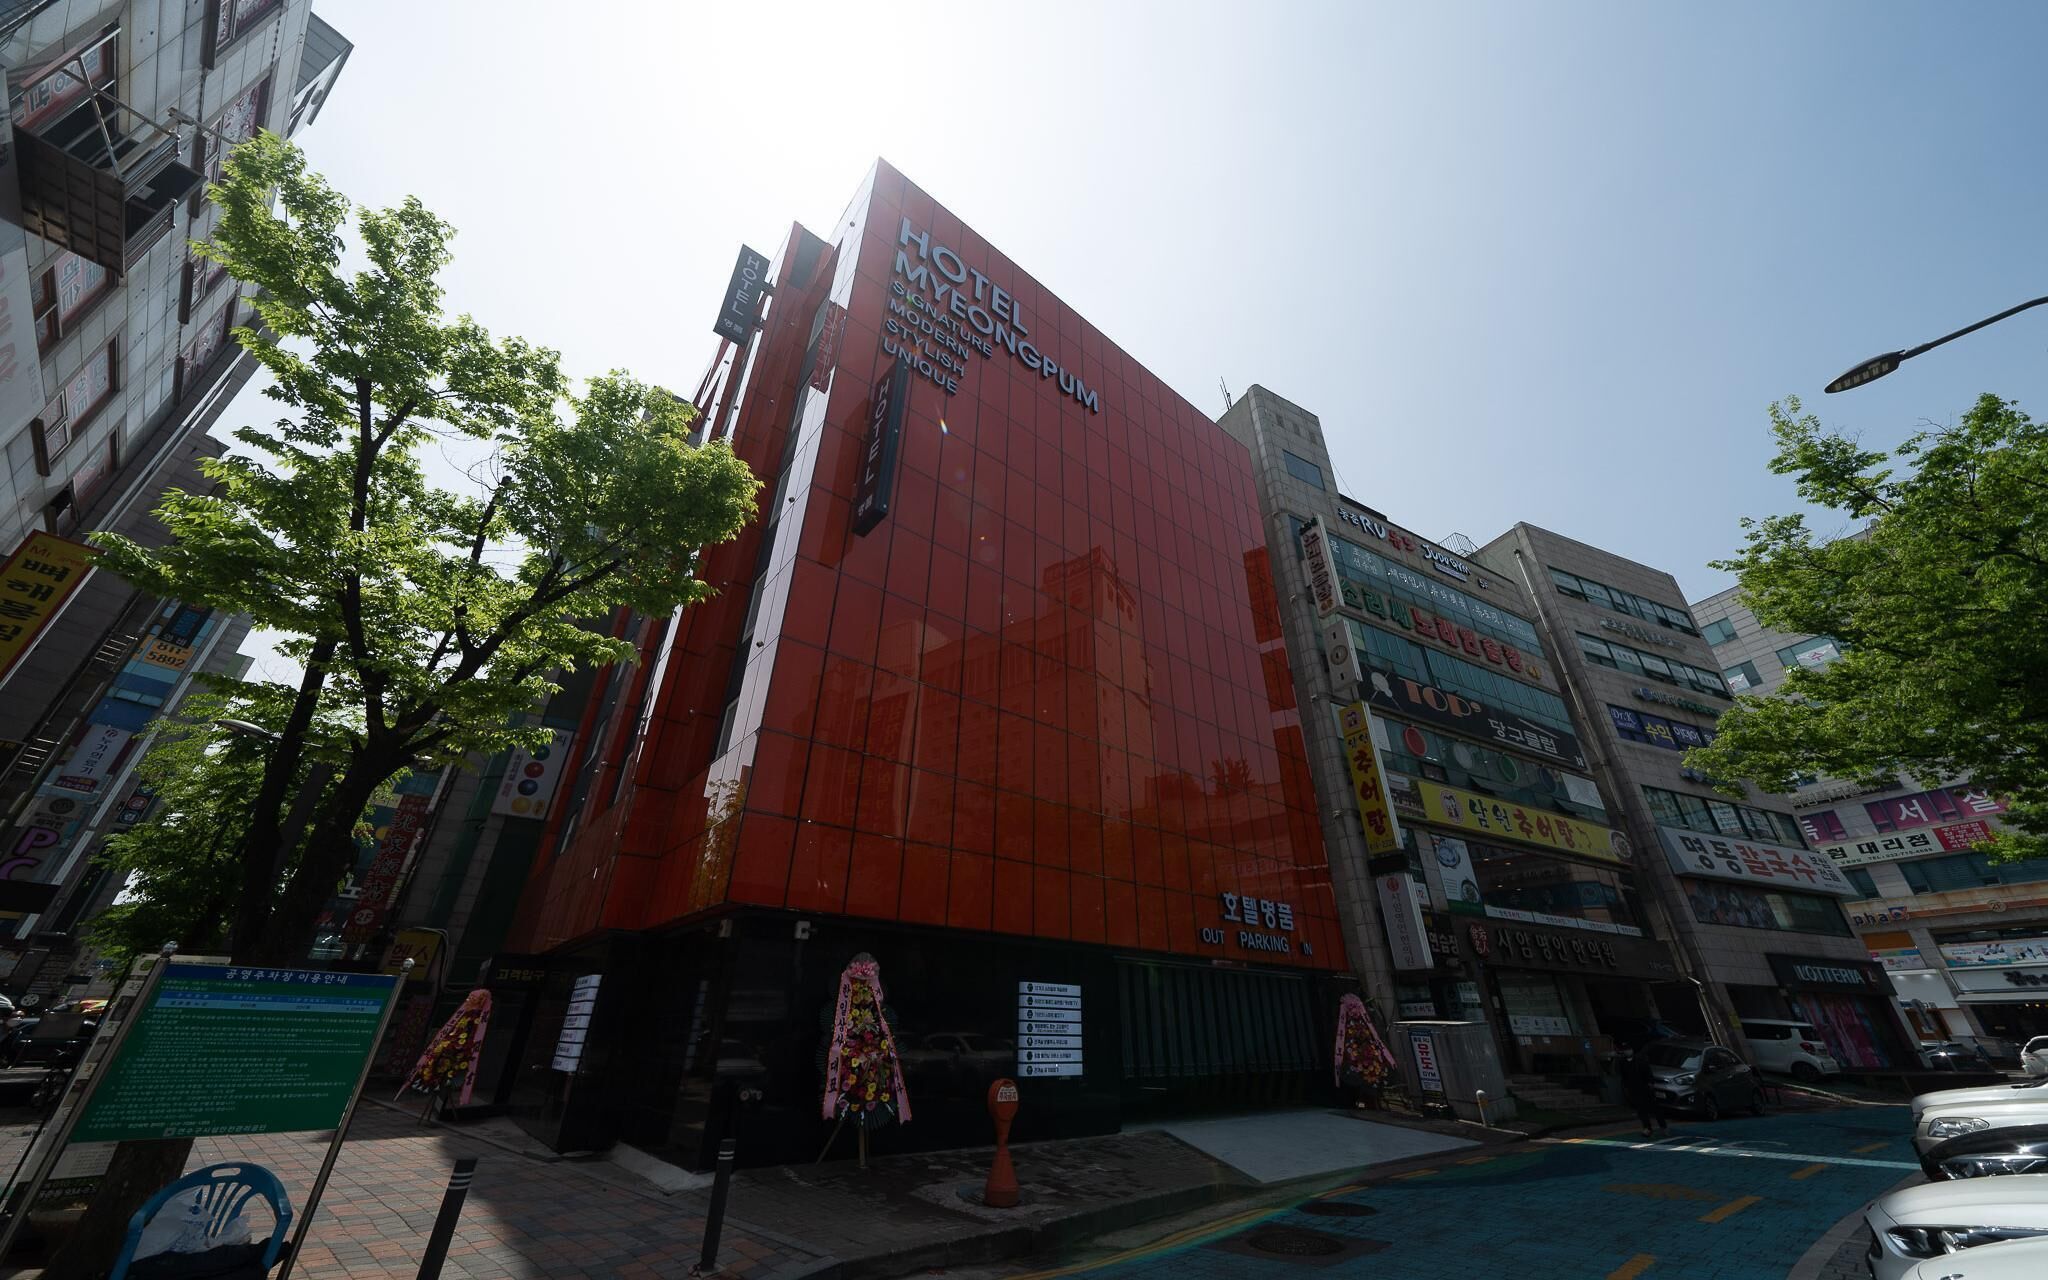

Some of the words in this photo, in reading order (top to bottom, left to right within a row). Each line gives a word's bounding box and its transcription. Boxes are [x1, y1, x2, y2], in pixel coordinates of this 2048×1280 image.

[731, 255, 760, 318] HOTEL
[900, 216, 1028, 336] HOTEL
[885, 317, 965, 377] STYLISH
[889, 297, 969, 361] MODERN
[892, 280, 993, 357] SIGNATURE
[895, 249, 1099, 412] MYEONGPUM
[883, 336, 958, 395] UNIQUE
[864, 377, 890, 486] HOTEL
[145, 651, 188, 668] 5892
[1487, 718, 1558, 755] 당구클럽
[1353, 749, 1388, 836] 추어탕
[1857, 833, 1931, 856] 대리점
[1222, 891, 1294, 931] 호텔명품
[1202, 928, 1225, 945] OUT
[1239, 931, 1290, 953] PARKING
[1302, 943, 1313, 956] IN
[225, 969, 295, 982] 공영주차장
[297, 972, 349, 986] 이용안내
[1793, 964, 1866, 986] LOTTERIA
